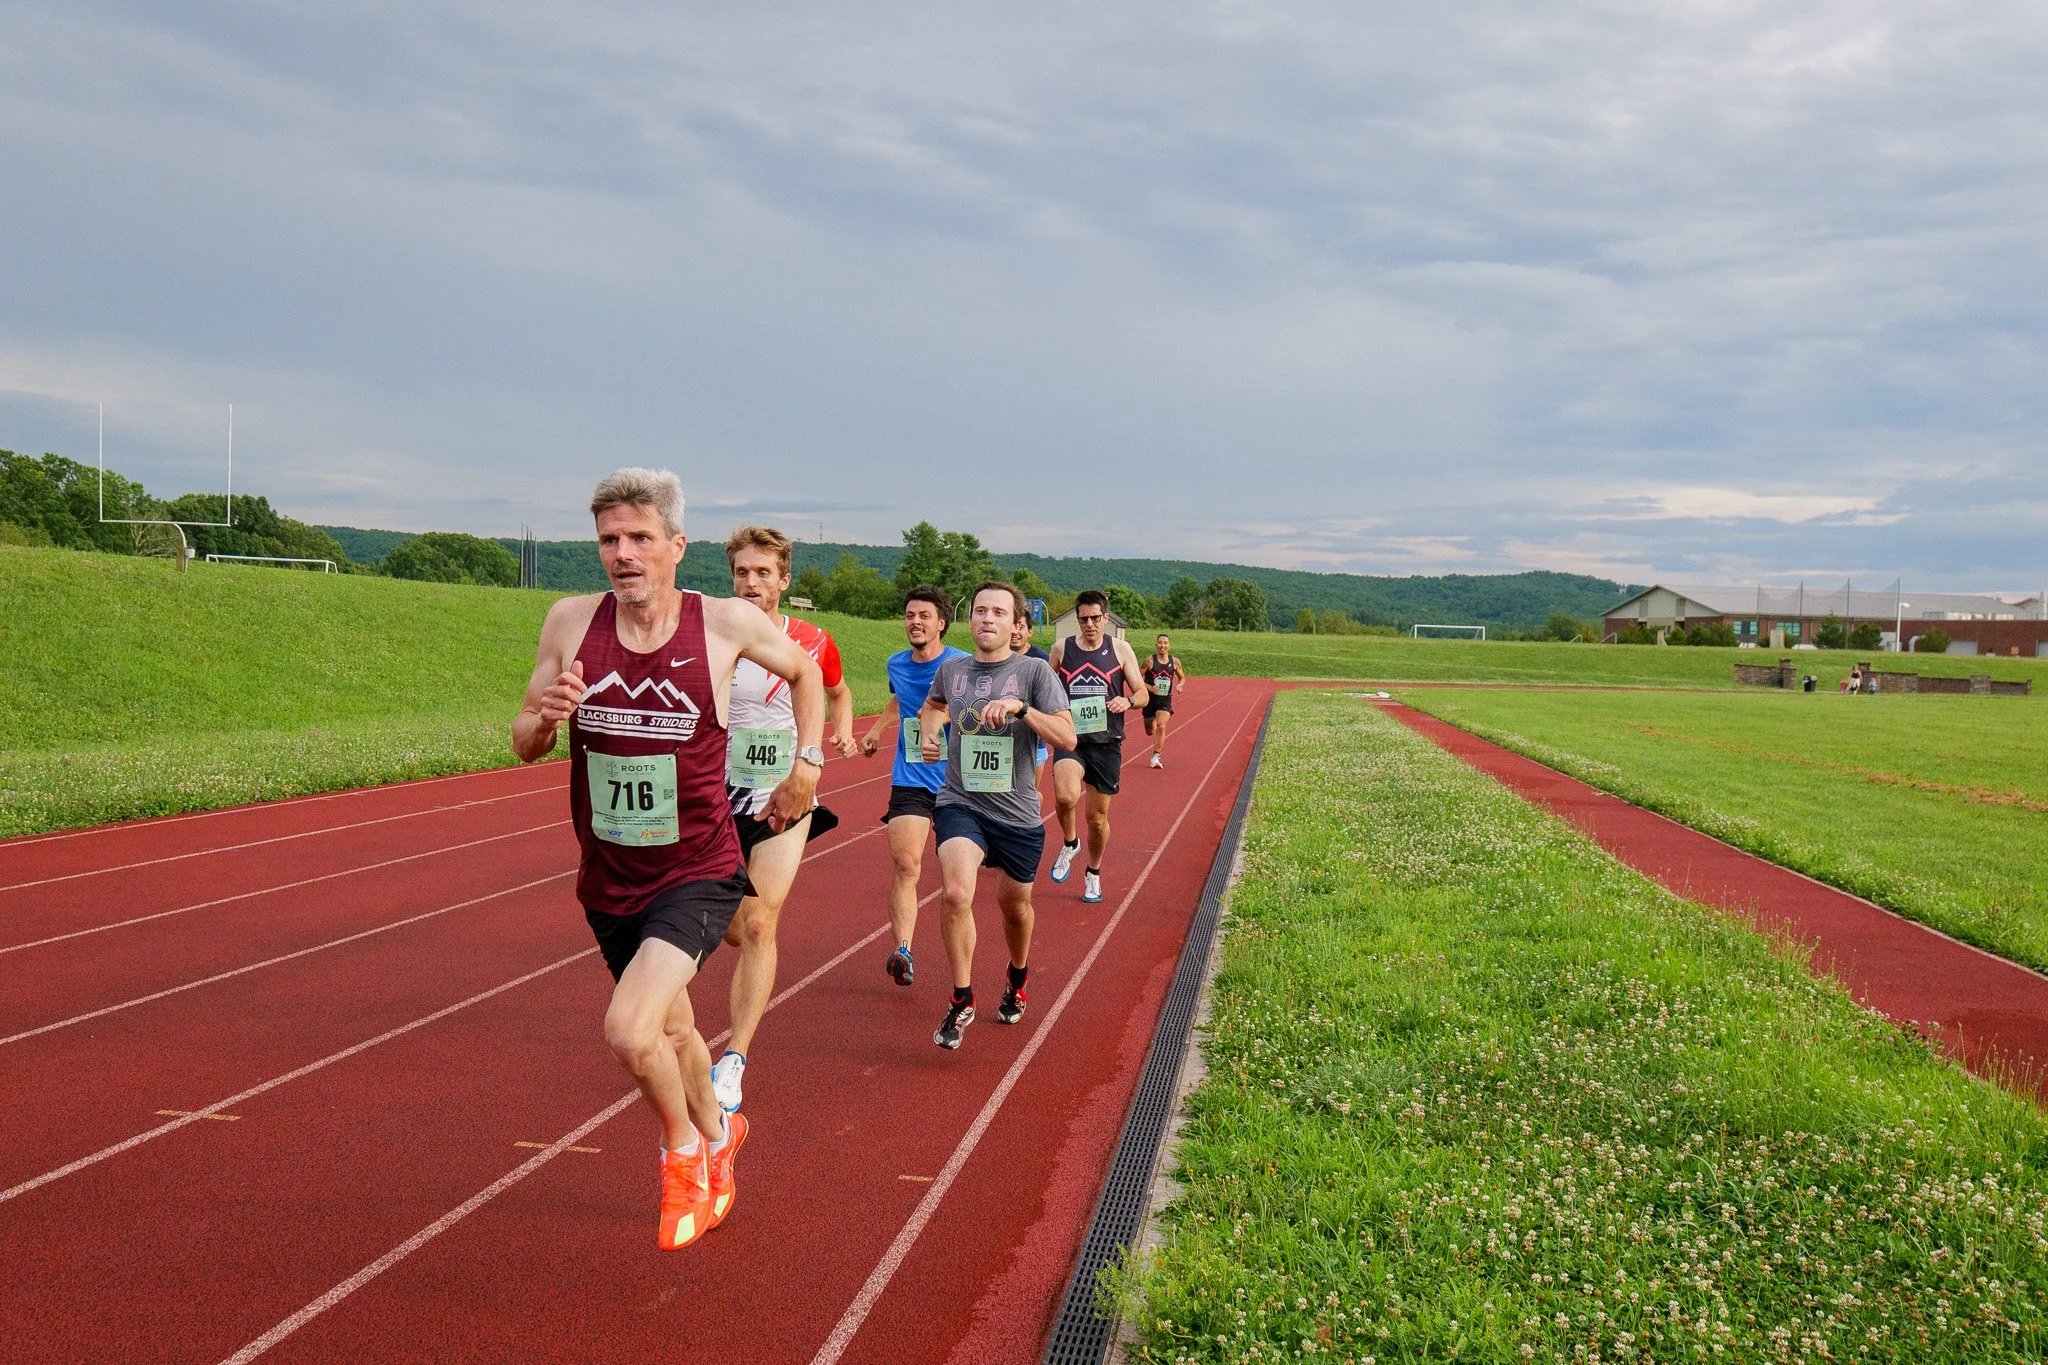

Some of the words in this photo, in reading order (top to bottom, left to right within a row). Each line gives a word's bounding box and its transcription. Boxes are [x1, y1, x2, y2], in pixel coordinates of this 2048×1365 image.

[952, 674, 1020, 697] USA
[578, 708, 642, 725] BLACKSBURG
[649, 717, 698, 729] STRIDERS
[1080, 706, 1099, 719] 434
[745, 744, 777, 766] 448
[972, 750, 999, 771] 705
[621, 764, 656, 772] ROOTS
[607, 779, 655, 811] 716
